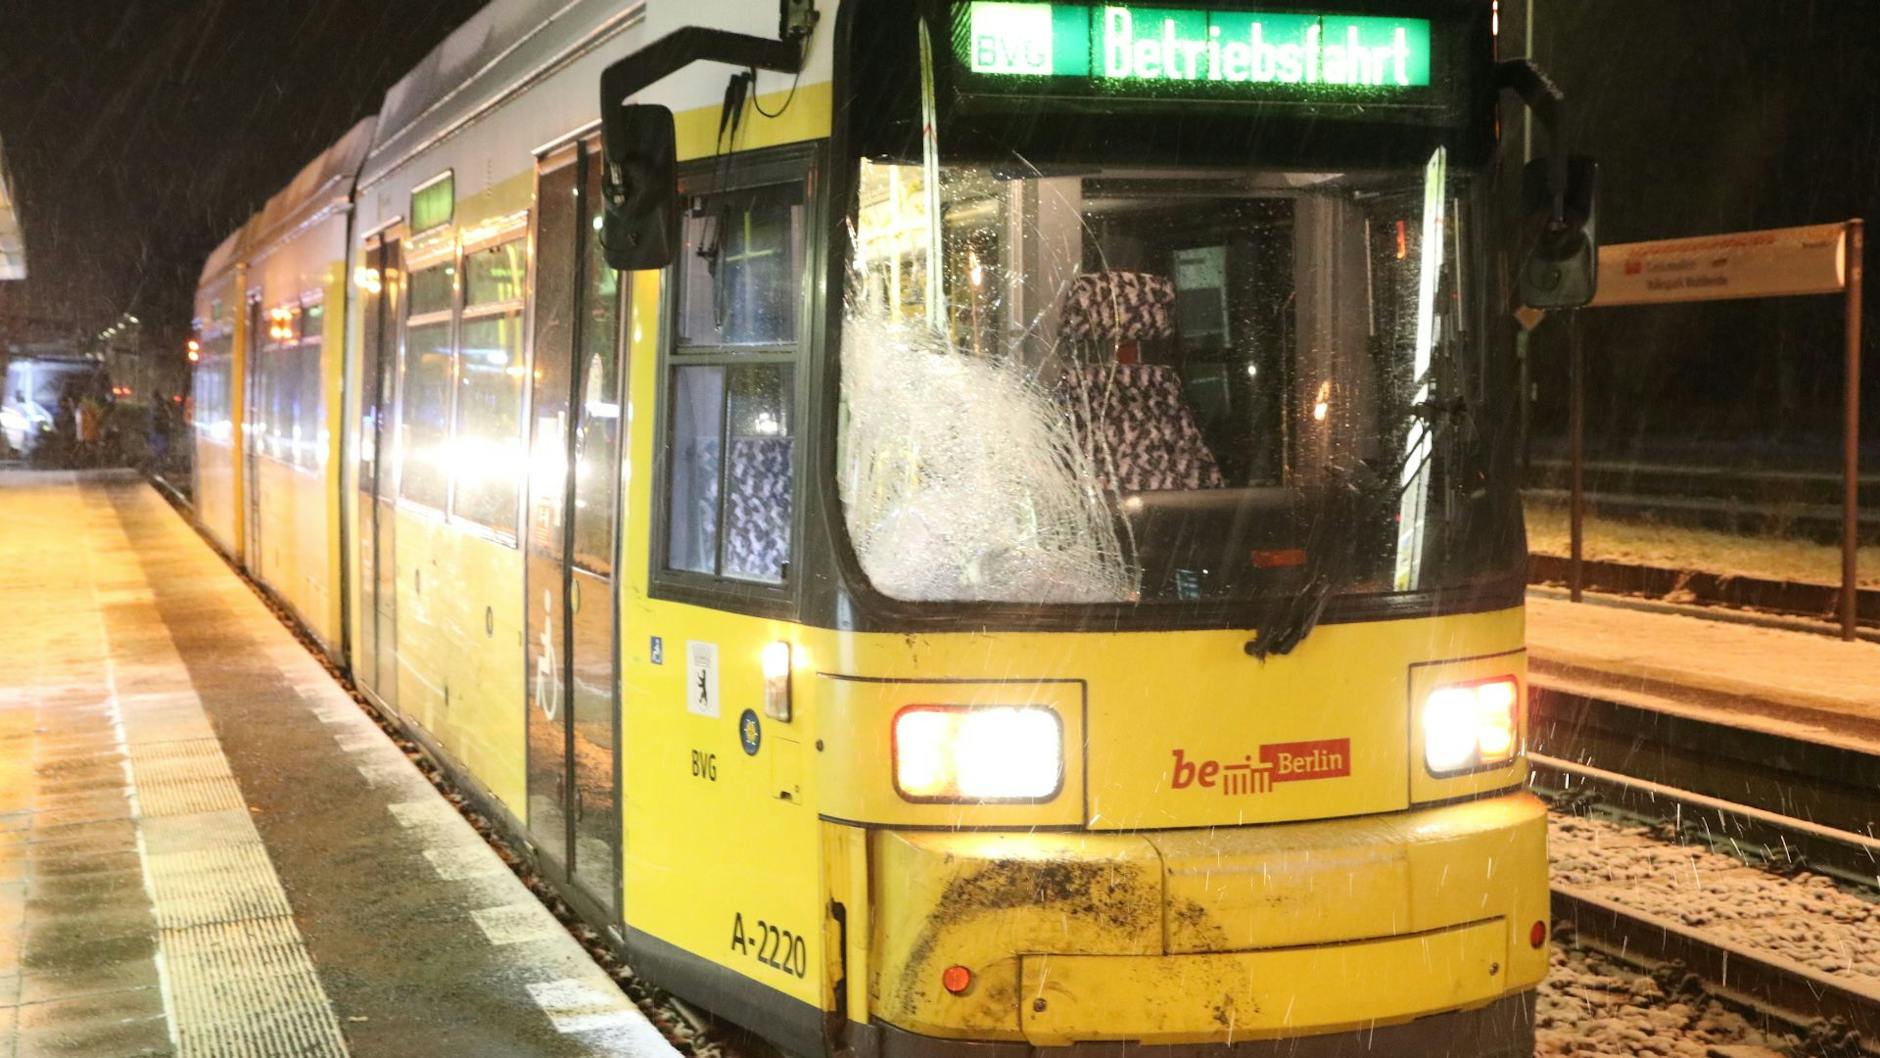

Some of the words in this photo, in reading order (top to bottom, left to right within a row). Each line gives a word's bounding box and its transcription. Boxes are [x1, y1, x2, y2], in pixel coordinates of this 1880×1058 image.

[977, 34, 1045, 67] BVG
[1104, 5, 1410, 87] Betriebsfahrt
[691, 749, 717, 781] BVG
[1171, 749, 1220, 789] be
[1277, 750, 1343, 775] Berlin
[732, 912, 806, 979] A-2220
